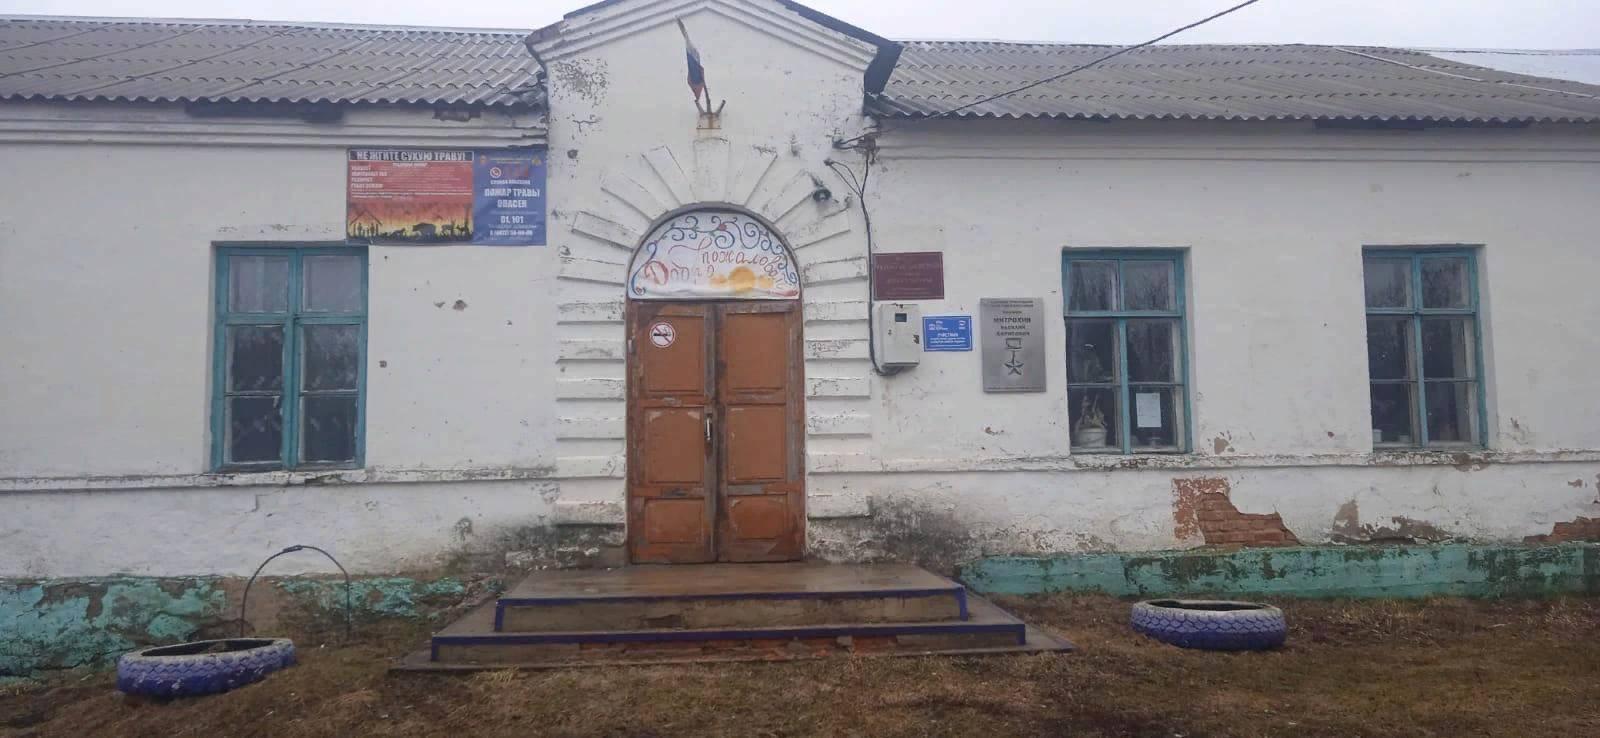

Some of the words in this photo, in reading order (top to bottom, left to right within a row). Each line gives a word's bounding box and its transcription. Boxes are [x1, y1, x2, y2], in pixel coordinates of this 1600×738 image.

[357, 151, 369, 160] НЕ
[369, 151, 399, 160] ЖГИТЕ
[400, 151, 433, 160] СУХУЮ
[434, 151, 466, 160] ТРАВУ!
[484, 188, 511, 197] ПОЖАР
[512, 188, 540, 197] ТРАВЫ
[497, 199, 527, 208] ОПАСЕН
